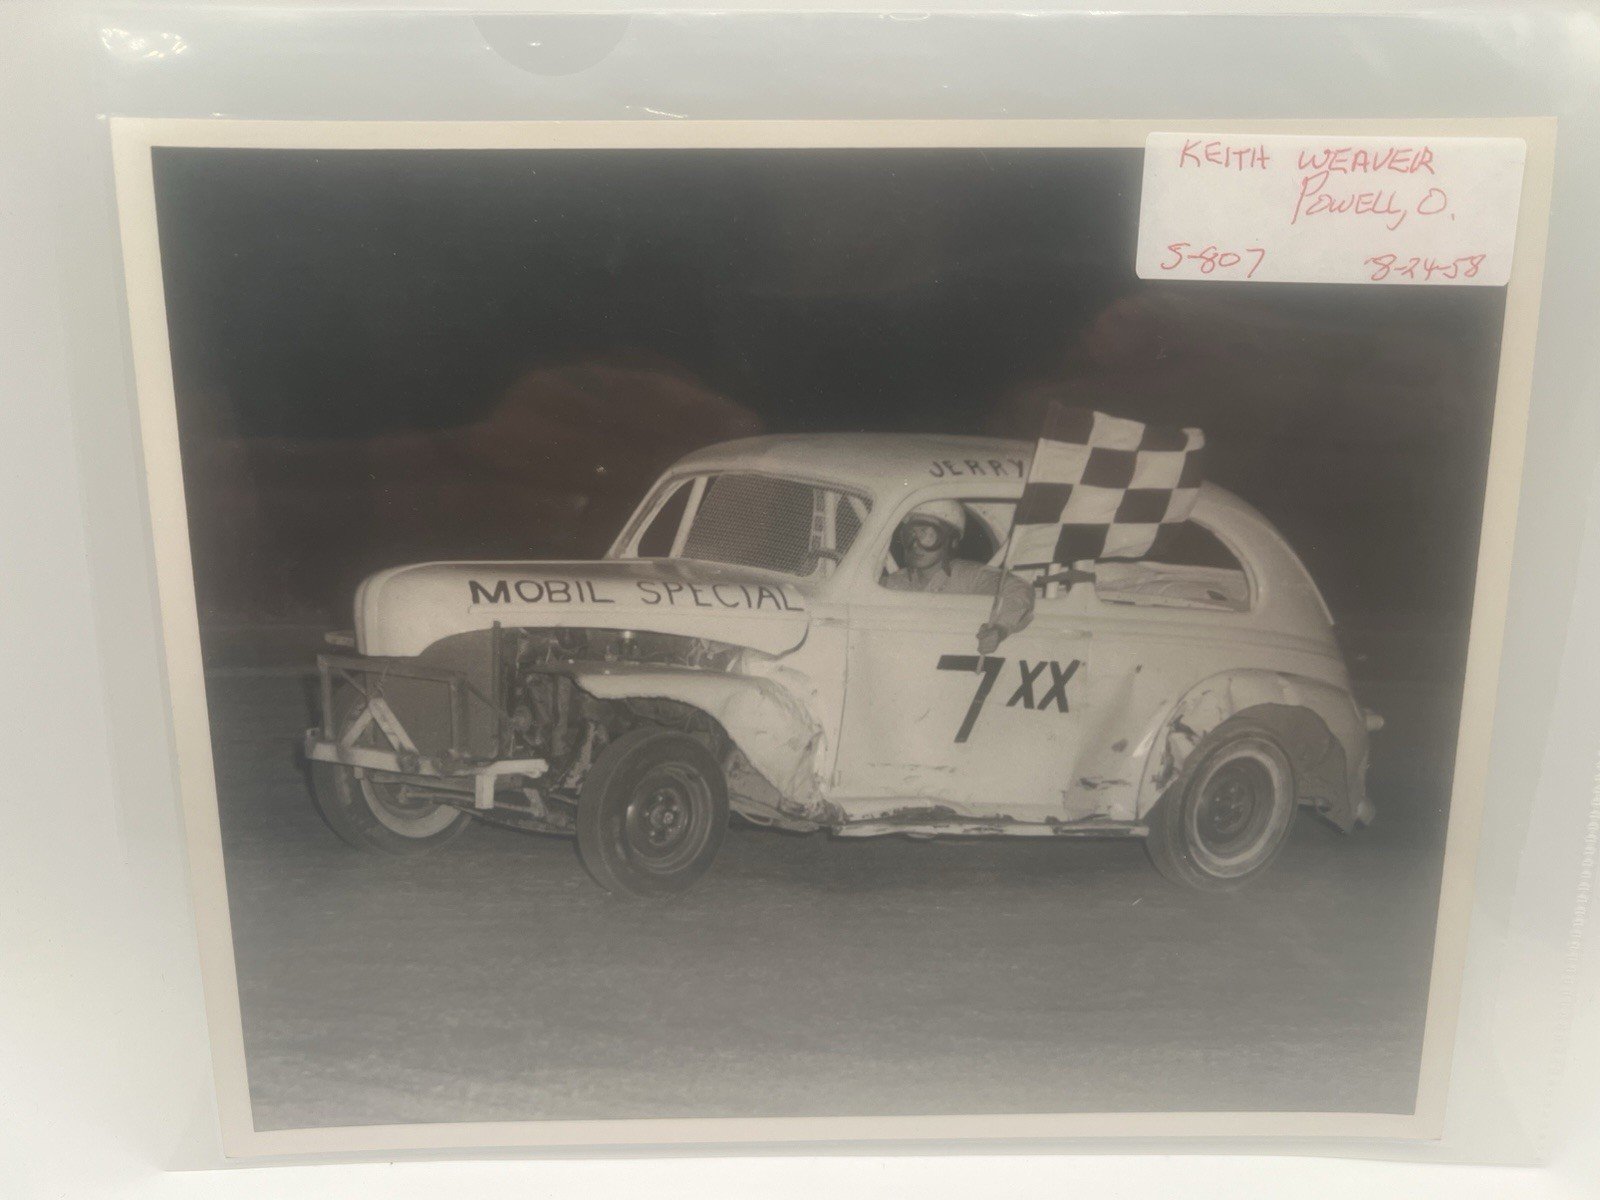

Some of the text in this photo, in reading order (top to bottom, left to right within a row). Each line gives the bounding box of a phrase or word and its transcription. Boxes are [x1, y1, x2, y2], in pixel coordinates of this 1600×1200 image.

[1180, 139, 1436, 175] KEITH WEAVER
[1417, 188, 1456, 221] O.
[1363, 253, 1487, 281] 8-24-58
[929, 459, 1025, 478] JERRY
[468, 580, 805, 612] MOBIL SPECIAL
